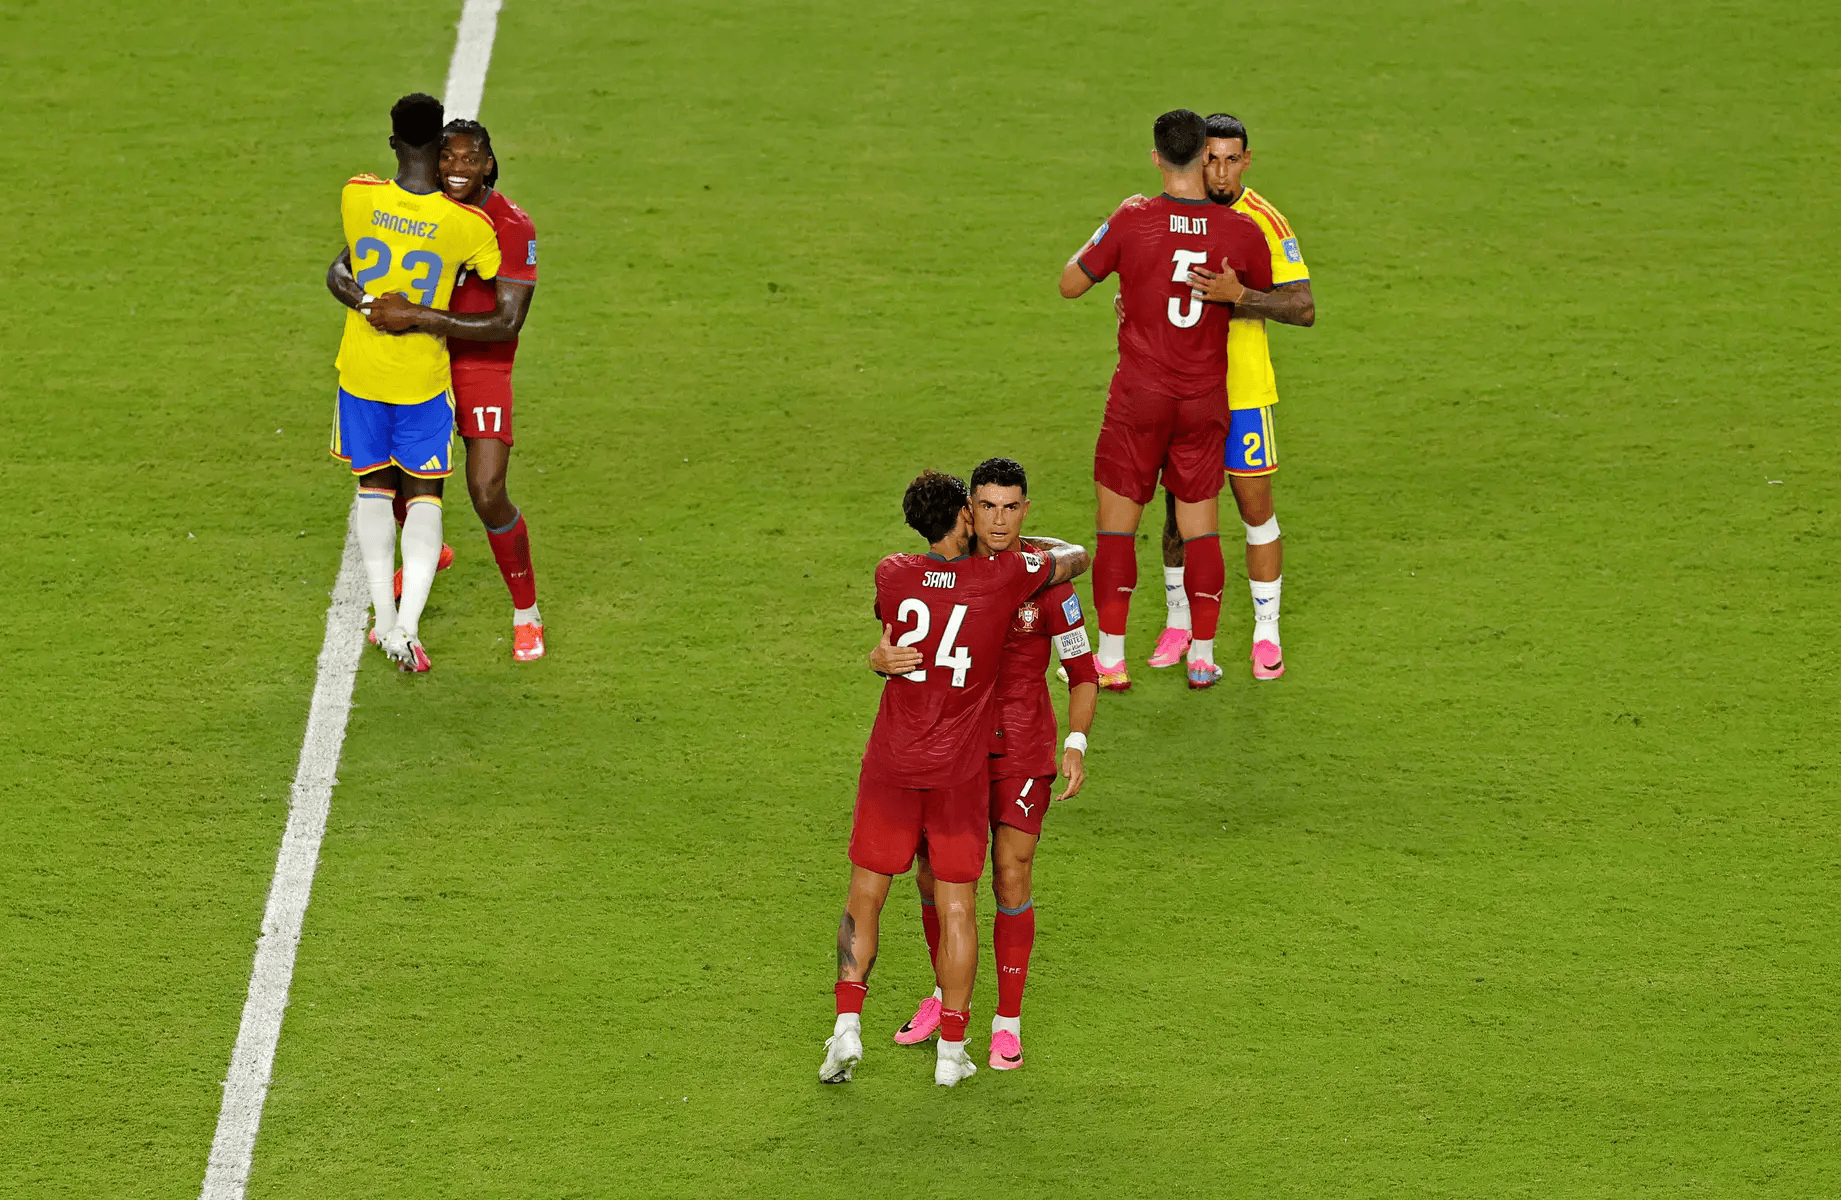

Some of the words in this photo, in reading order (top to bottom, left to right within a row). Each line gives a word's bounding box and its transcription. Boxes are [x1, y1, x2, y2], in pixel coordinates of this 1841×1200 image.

[371, 209, 439, 239] SANCHEZ
[1169, 214, 1208, 236] DALOT
[355, 236, 443, 308] 23
[1167, 249, 1208, 328] 5
[472, 406, 502, 432] 17
[1243, 432, 1263, 466] 2
[922, 571, 957, 589] SAMU
[896, 598, 973, 688] 24
[1061, 631, 1081, 640] FOOTBALL
[1062, 635, 1083, 647] UNITES
